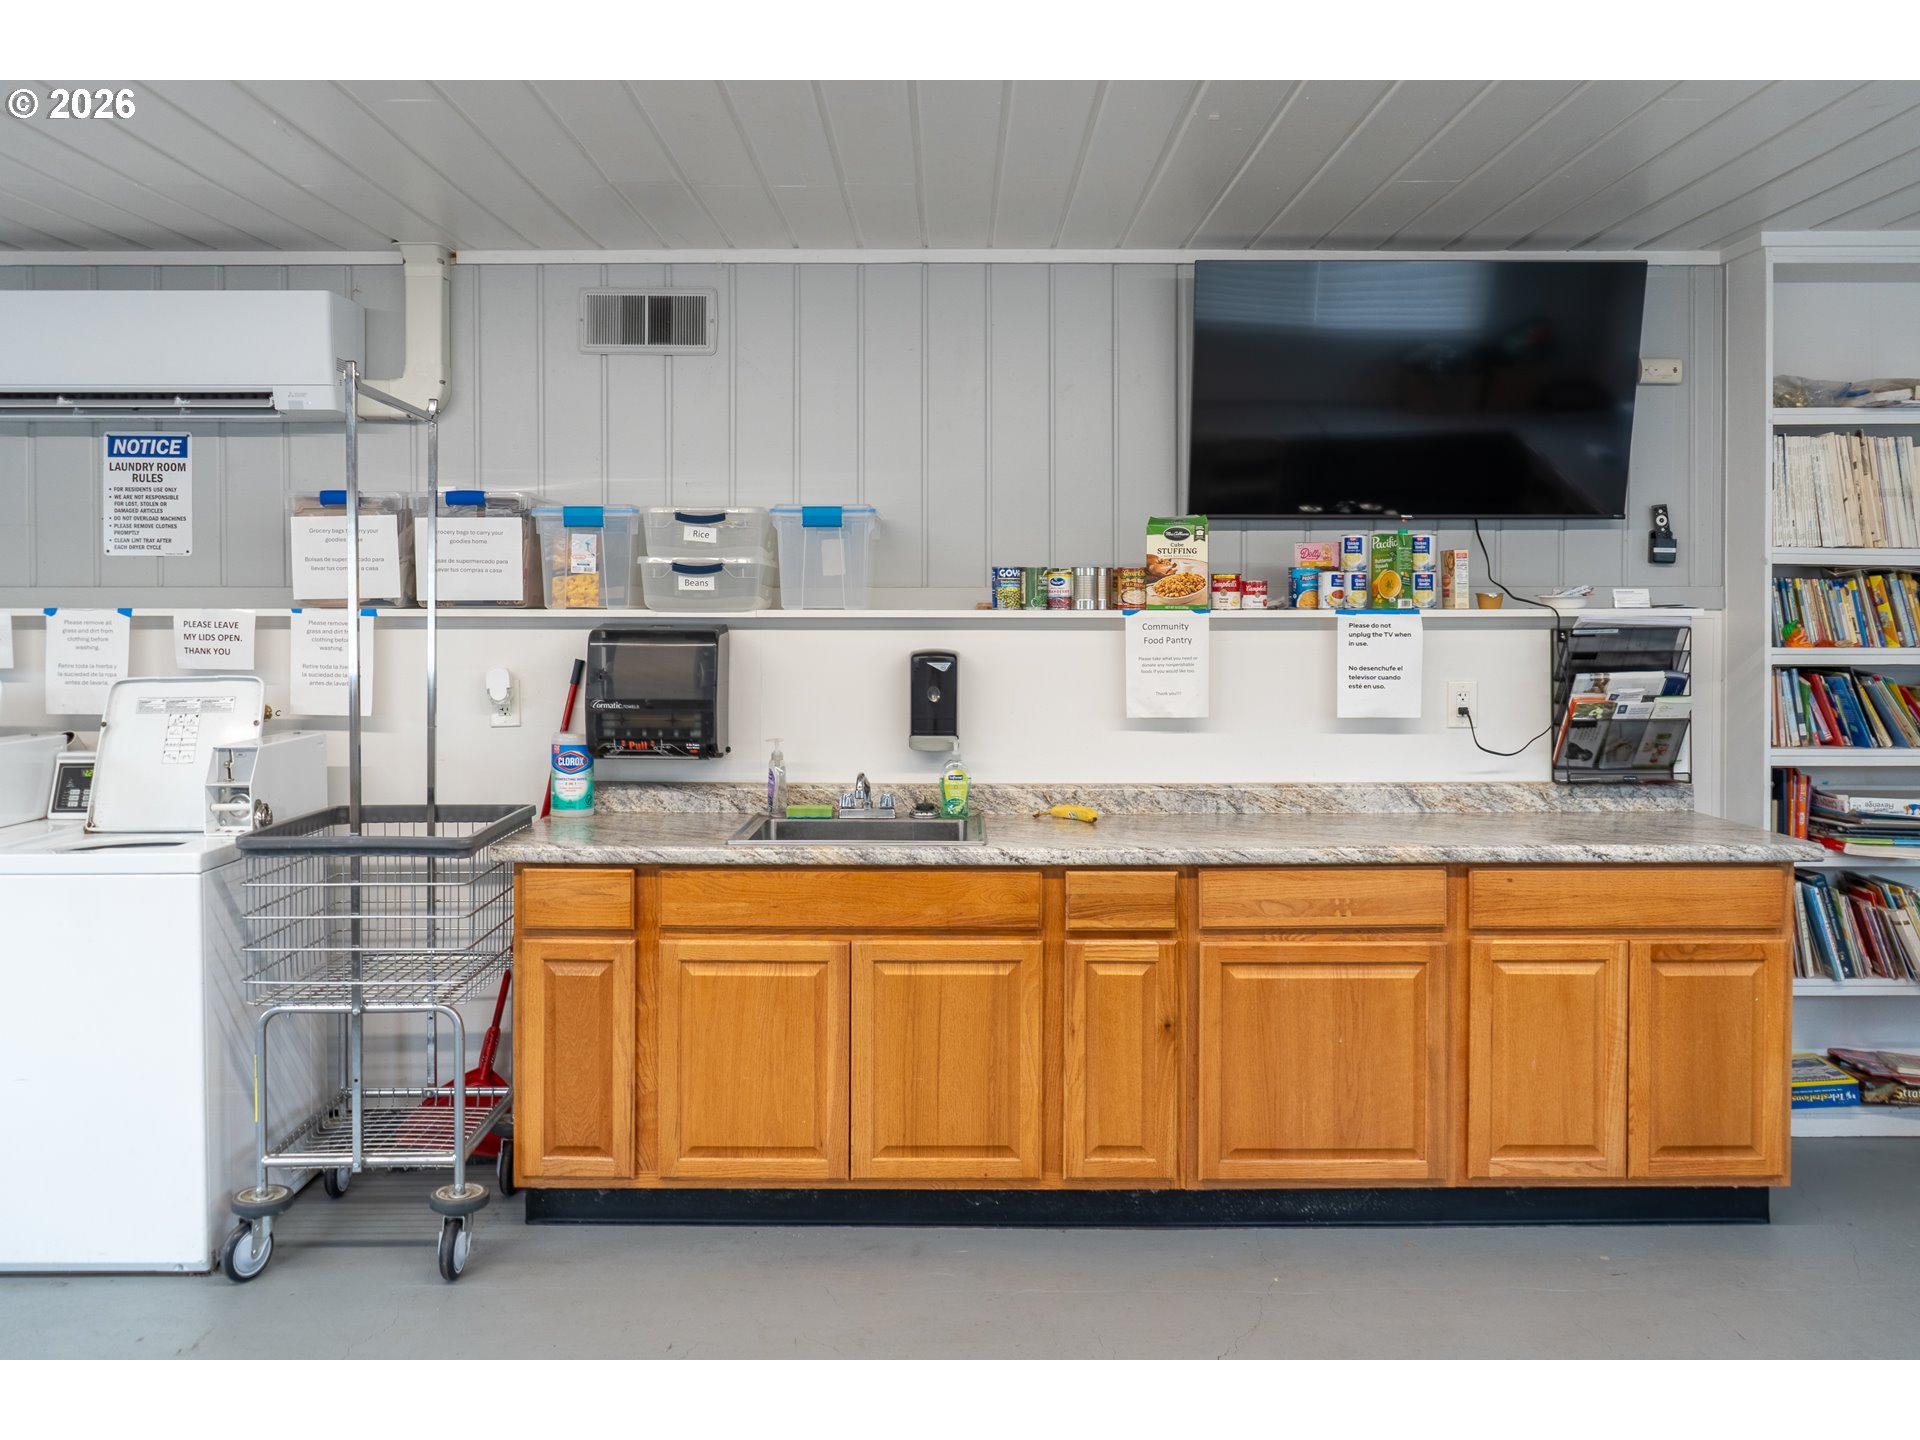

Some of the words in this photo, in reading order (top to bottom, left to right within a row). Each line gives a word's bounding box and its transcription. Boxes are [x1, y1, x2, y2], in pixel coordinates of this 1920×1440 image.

[112, 439, 182, 455] NOTICE
[109, 462, 155, 472] LAUNDRY
[156, 462, 187, 472] ROOM
[132, 474, 164, 483] RULES
[693, 530, 710, 539] Rice
[1372, 536, 1398, 550] Pacific
[1157, 547, 1197, 555] STUFFING
[1300, 548, 1320, 560] Dolly
[684, 579, 709, 587] Beans
[183, 620, 212, 629] PLEASE
[214, 621, 239, 630] LEAVE
[1142, 622, 1190, 631] Community
[183, 633, 197, 642] MY
[198, 634, 216, 642] LIDS
[218, 634, 243, 642] OPEN.
[1143, 636, 1164, 645] Food
[1166, 636, 1192, 645] Pantry
[184, 647, 212, 655] THANK
[213, 648, 231, 656] YOU
[628, 741, 648, 750] Pull
[558, 757, 585, 766] CLOROX
[1899, 1088, 1920, 1099] Stra
